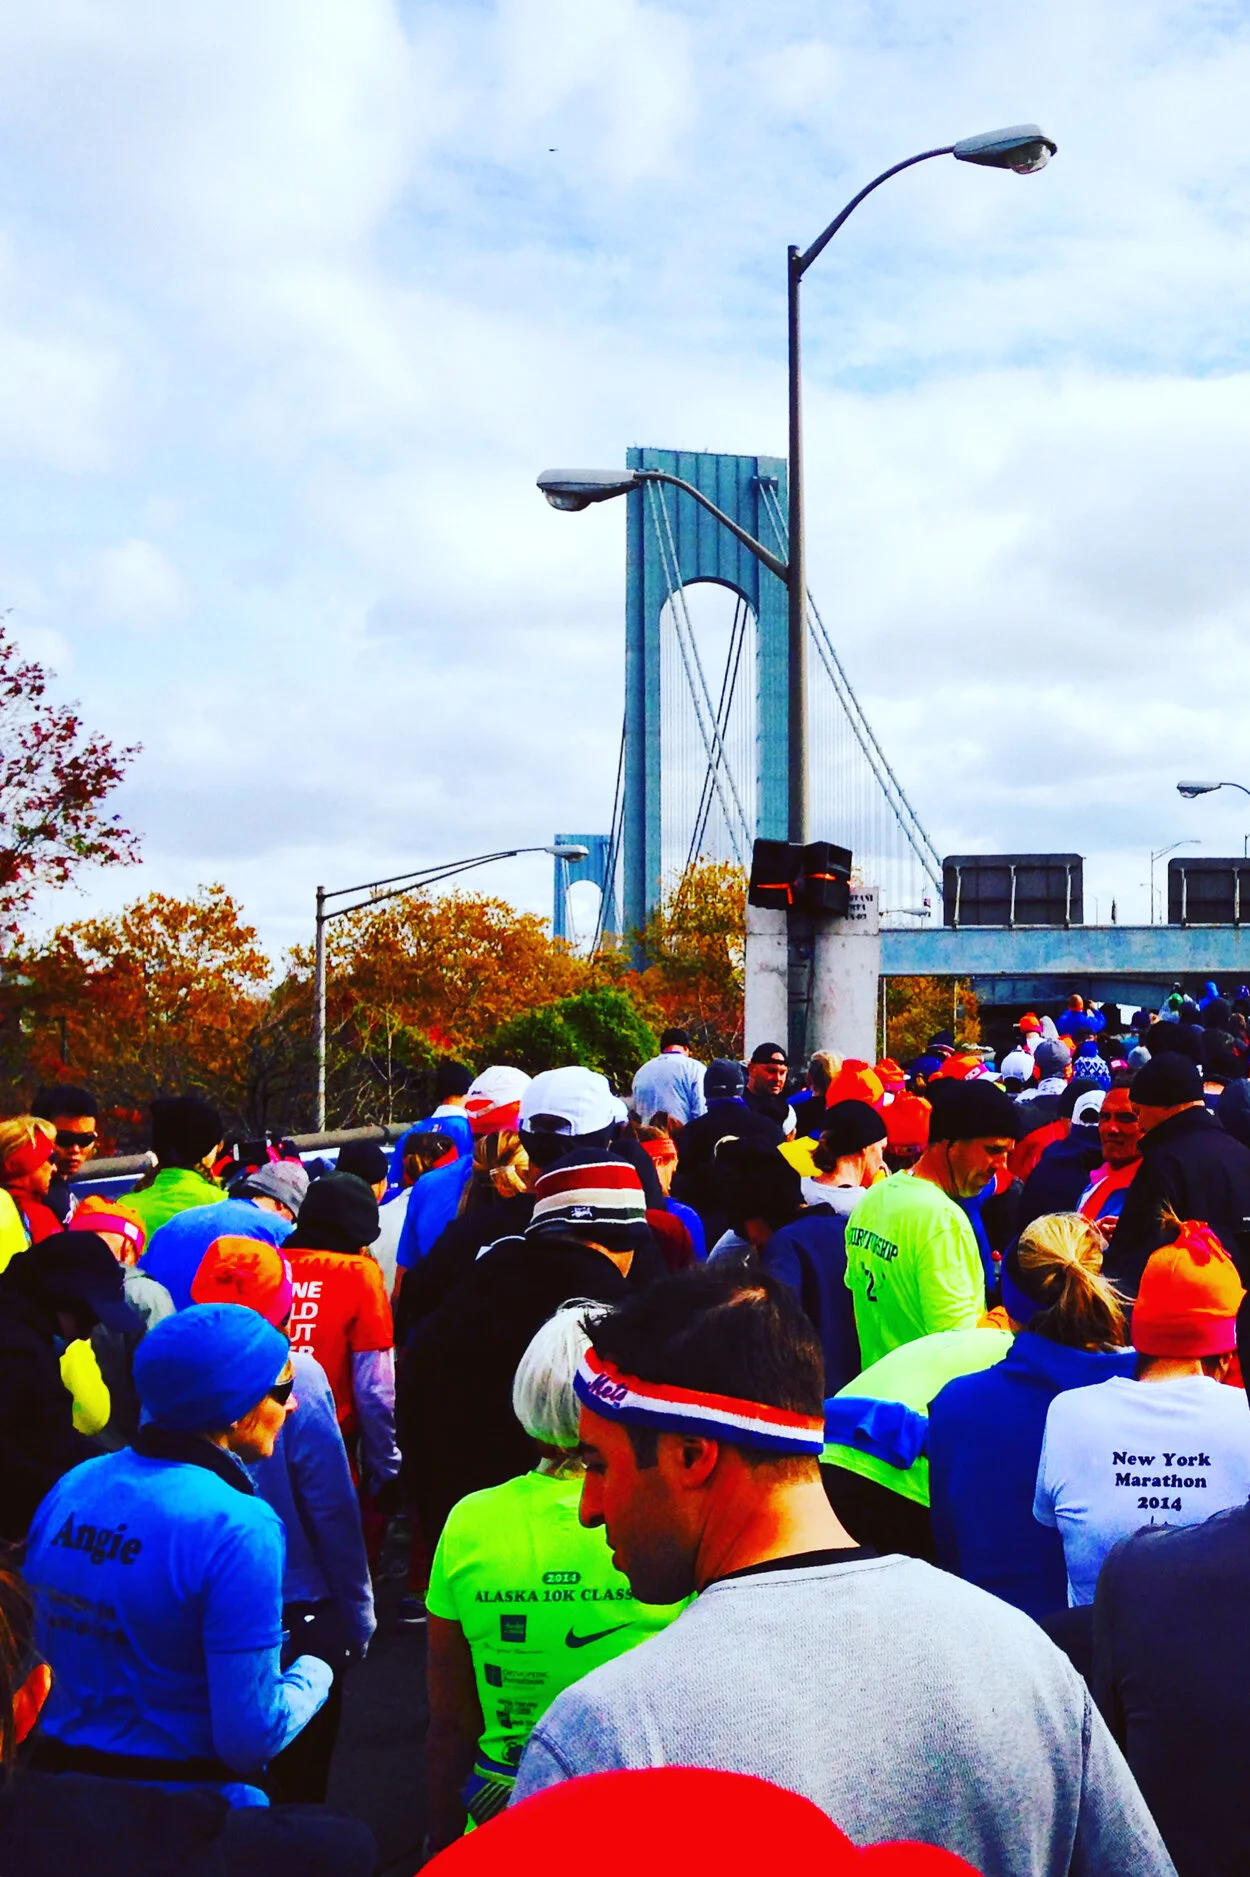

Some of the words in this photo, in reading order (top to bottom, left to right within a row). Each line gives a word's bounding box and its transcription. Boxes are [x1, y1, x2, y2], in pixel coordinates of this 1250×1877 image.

[292, 1281, 323, 1299] NE
[291, 1302, 319, 1320] LD
[291, 1323, 317, 1342] UT
[1112, 1451, 1156, 1466] New
[1162, 1452, 1212, 1467] York
[1115, 1472, 1208, 1488] Marathon
[1137, 1496, 1182, 1512] 2014
[51, 1512, 142, 1566] Angie
[546, 1572, 578, 1584] 2014
[475, 1590, 539, 1603] ALASKA
[544, 1589, 576, 1602] 10K
[580, 1587, 635, 1601] CLASS
